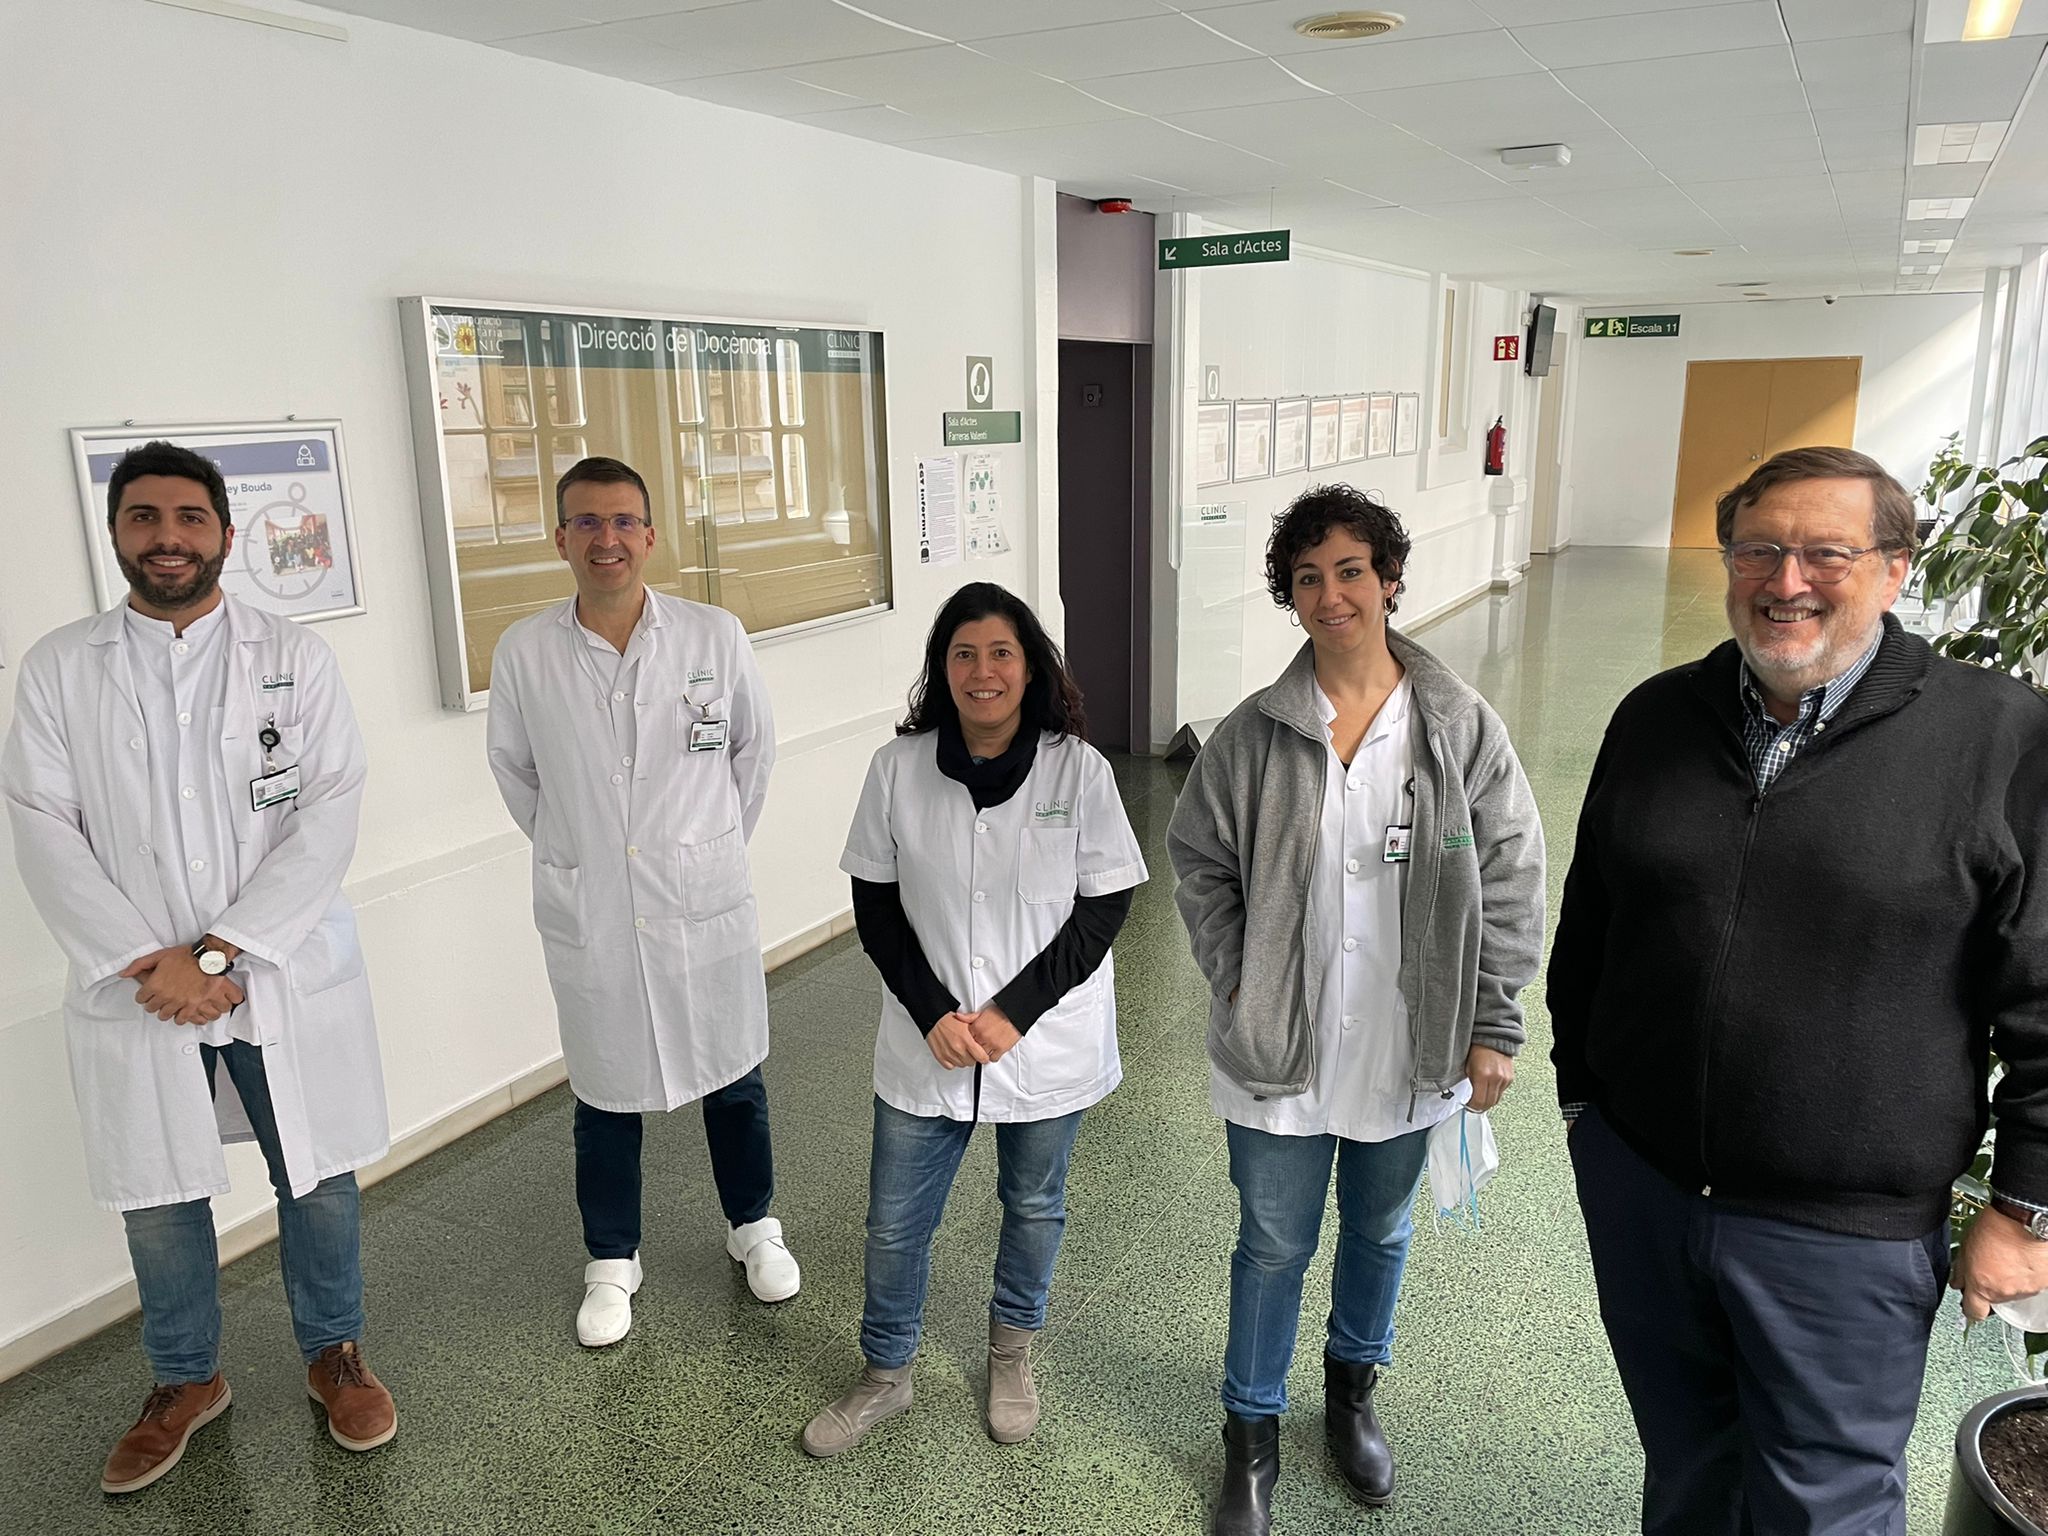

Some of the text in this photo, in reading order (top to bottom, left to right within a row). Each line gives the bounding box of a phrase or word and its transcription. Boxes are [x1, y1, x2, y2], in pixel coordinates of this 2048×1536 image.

[1202, 240, 1281, 256] Sala d'Actes
[451, 312, 502, 326] Corporació
[1630, 322, 1677, 333] Escala 11
[577, 322, 772, 355] Direcció de Docència
[947, 416, 978, 427] Sala d'Actes
[948, 431, 970, 441] Farreras
[241, 482, 272, 493] Bouda
